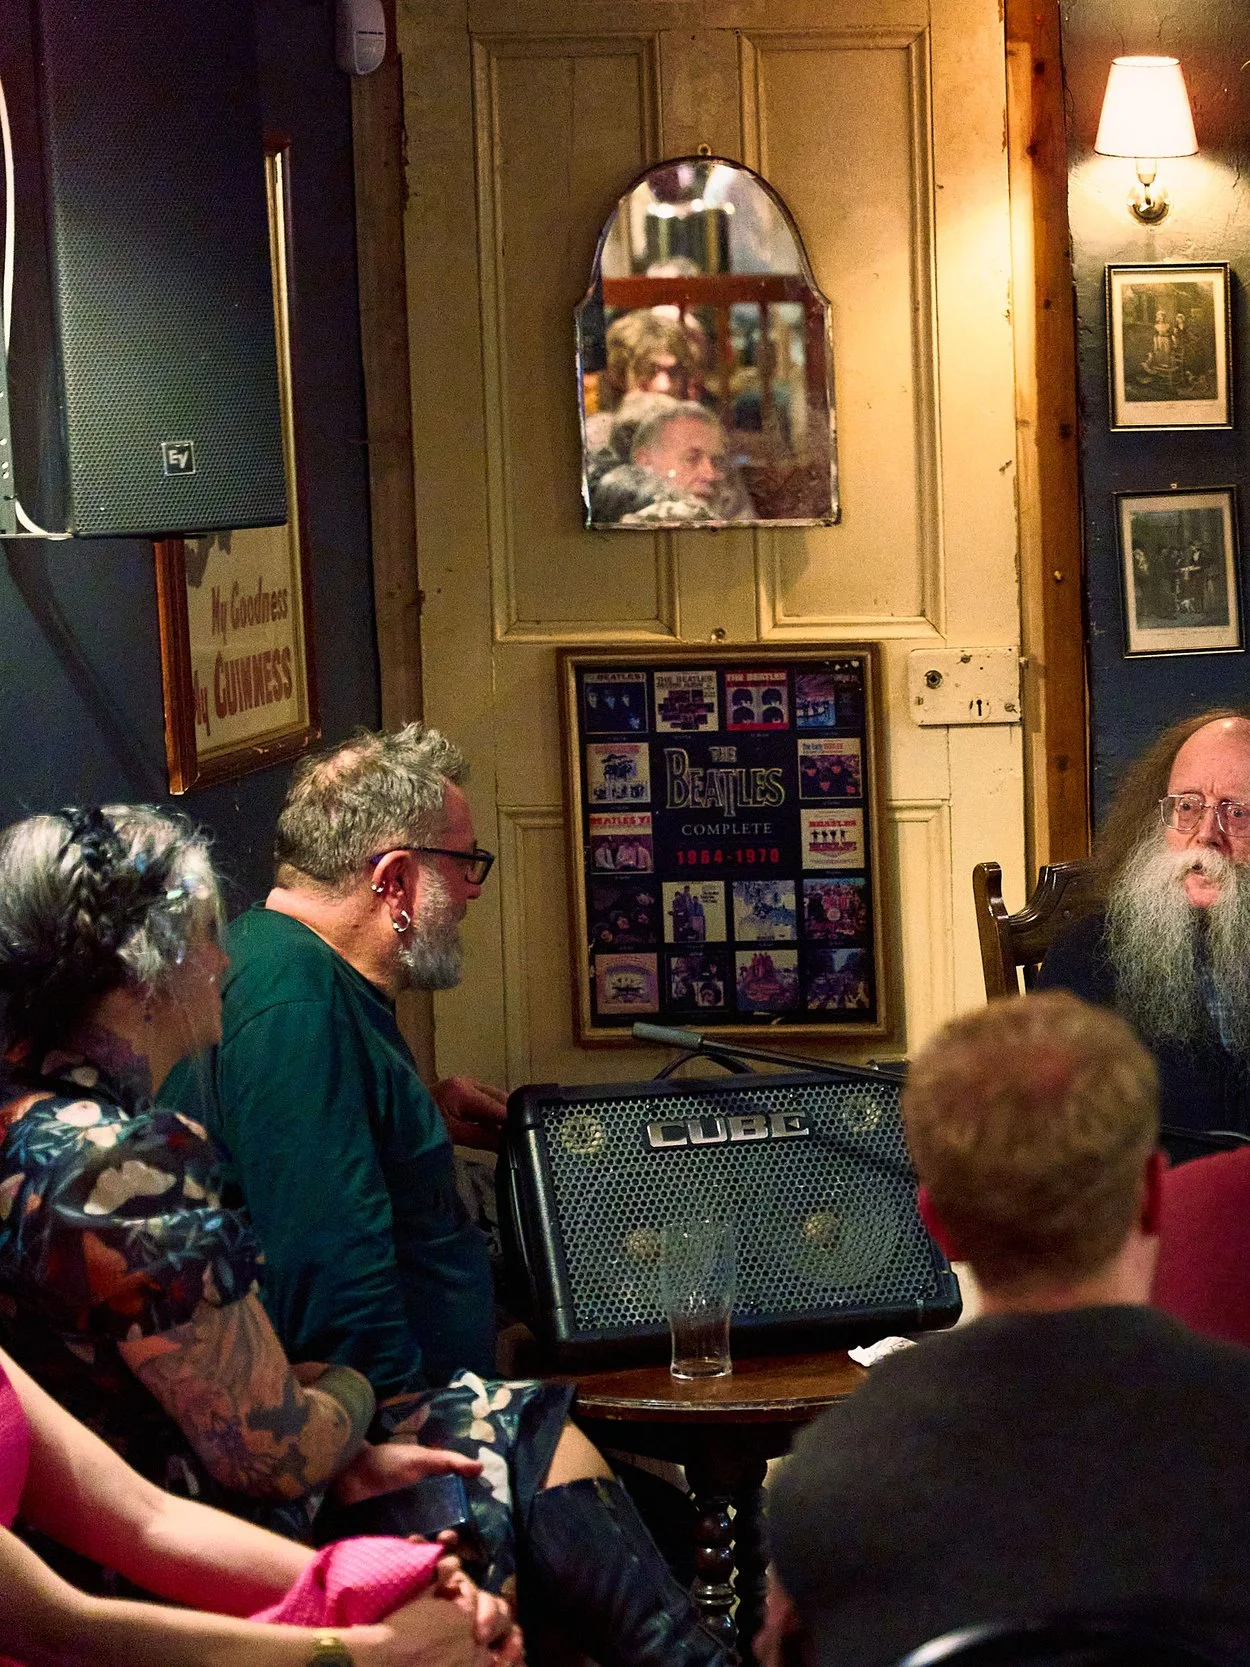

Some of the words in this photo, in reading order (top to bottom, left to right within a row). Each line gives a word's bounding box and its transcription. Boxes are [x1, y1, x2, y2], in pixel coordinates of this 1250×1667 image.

[168, 449, 190, 469] EV
[211, 585, 228, 646] My
[231, 576, 288, 629] Goodness
[214, 647, 293, 719] GUINNESS
[709, 746, 738, 762] THE
[664, 747, 786, 818] BEATLES
[681, 822, 773, 836] COMPLETE
[676, 847, 780, 865] 1964-1970
[646, 1111, 810, 1148] CUBE
